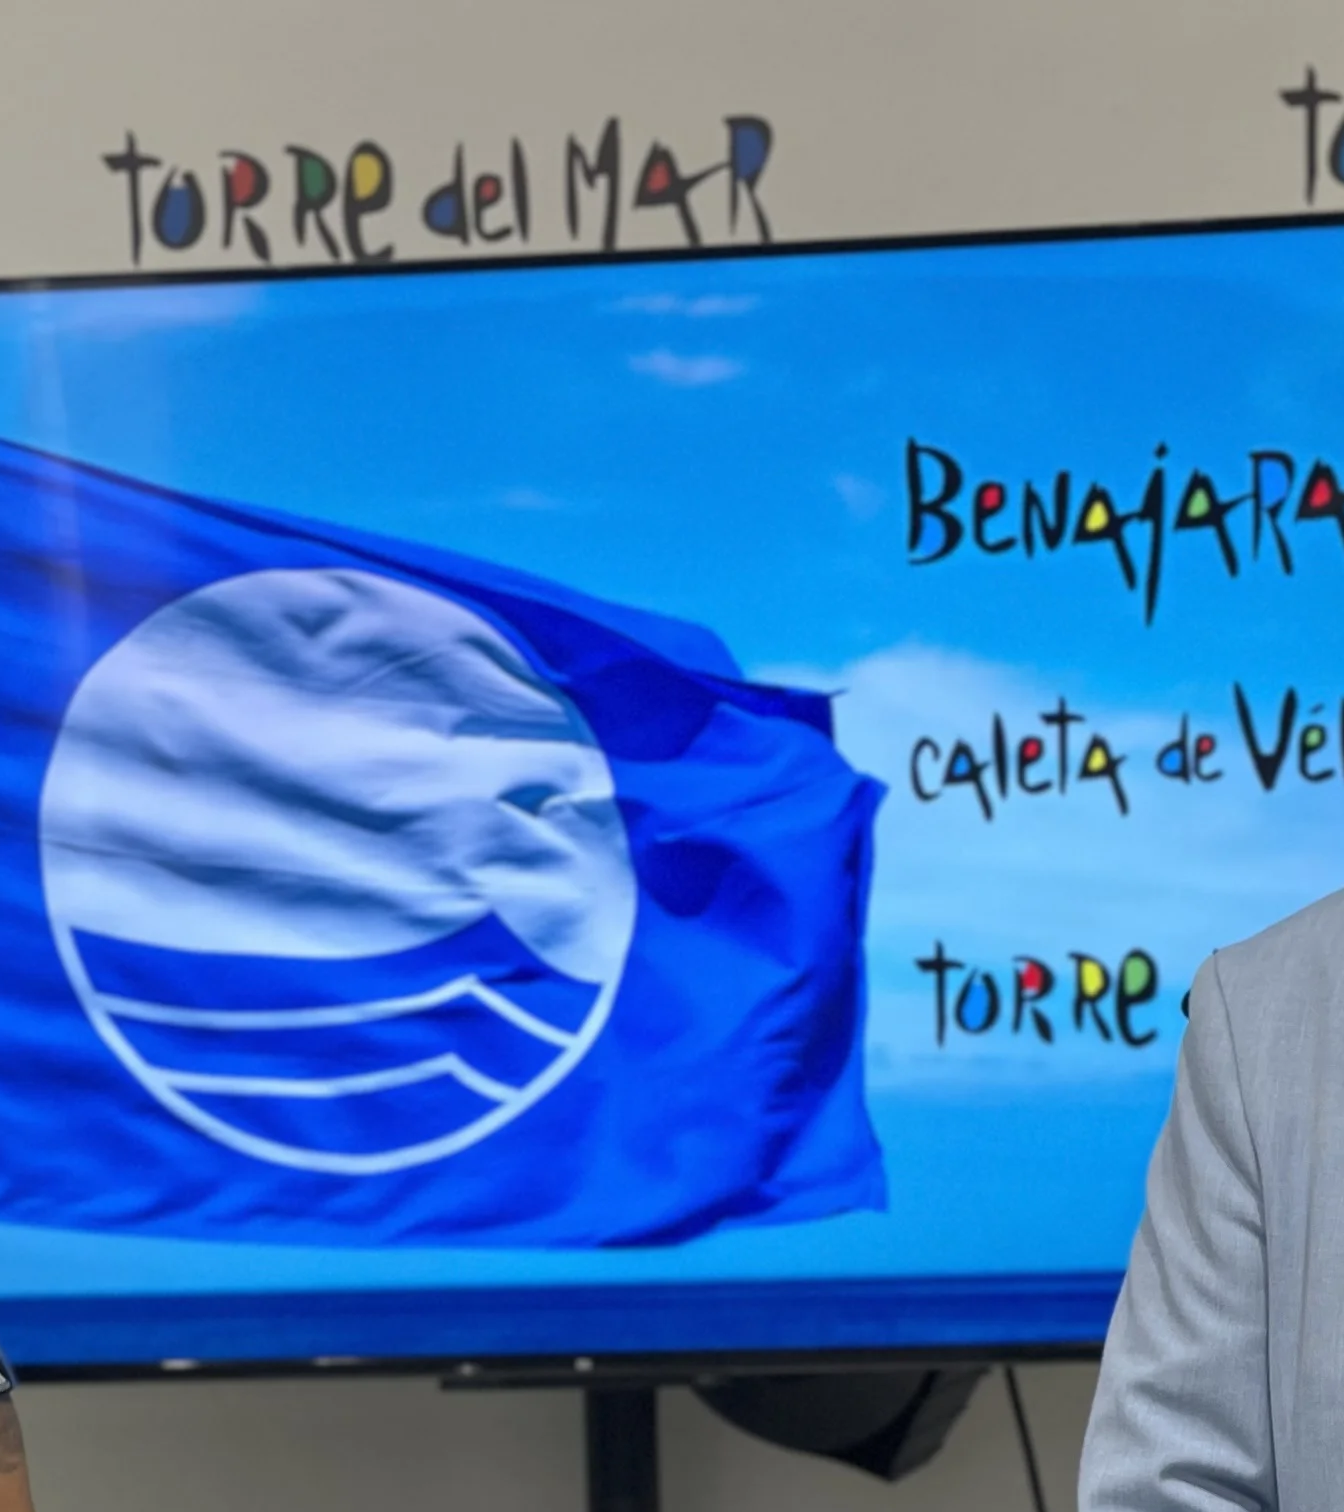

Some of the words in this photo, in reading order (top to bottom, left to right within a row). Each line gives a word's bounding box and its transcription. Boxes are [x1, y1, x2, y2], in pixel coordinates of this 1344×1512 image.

[422, 134, 532, 246] del
[566, 115, 776, 250] MAR
[1157, 713, 1224, 787] de
